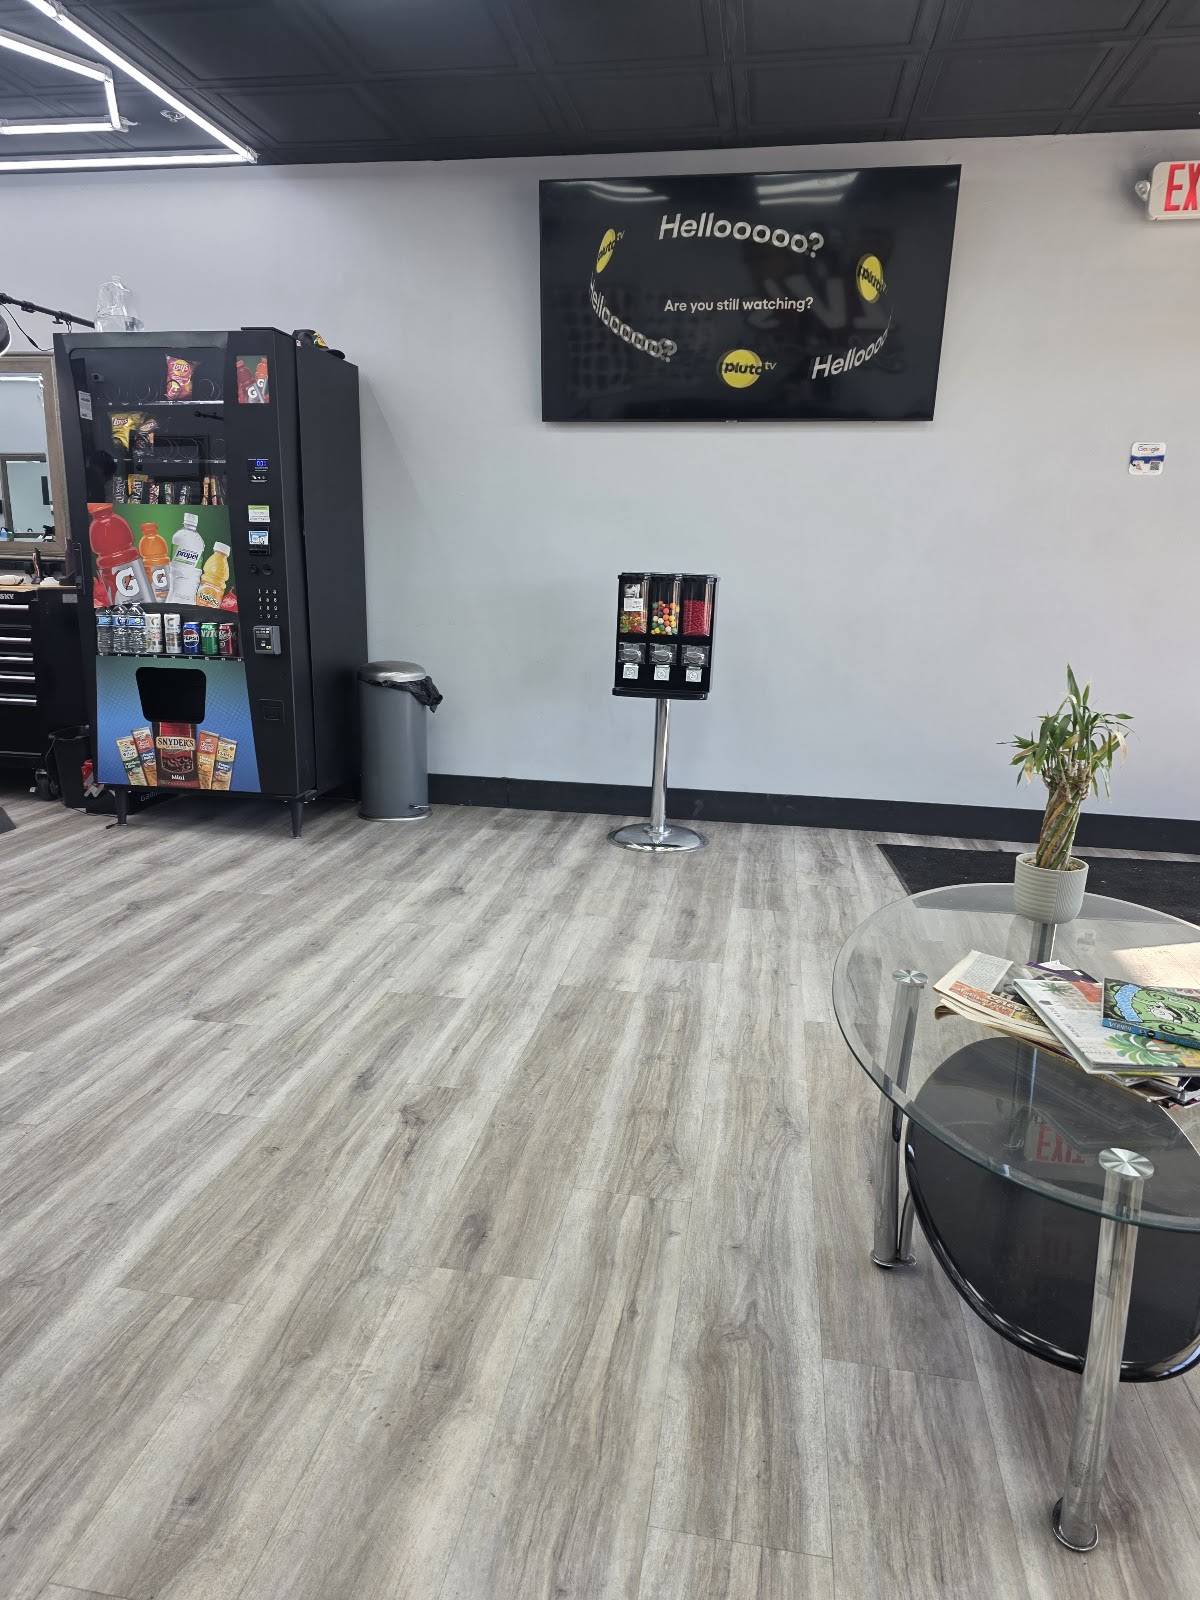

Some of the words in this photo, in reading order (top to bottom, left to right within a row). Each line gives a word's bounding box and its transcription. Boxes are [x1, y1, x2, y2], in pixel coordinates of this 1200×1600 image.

[664, 299, 687, 311] Are
[690, 301, 713, 313] you
[717, 298, 739, 310] still
[743, 296, 814, 312] watching?
[248, 387, 258, 399] G
[1138, 445, 1160, 454] Google
[176, 550, 199, 560] propel
[115, 567, 140, 598] G
[152, 568, 168, 588] G
[157, 738, 194, 747] SNYDER'S
